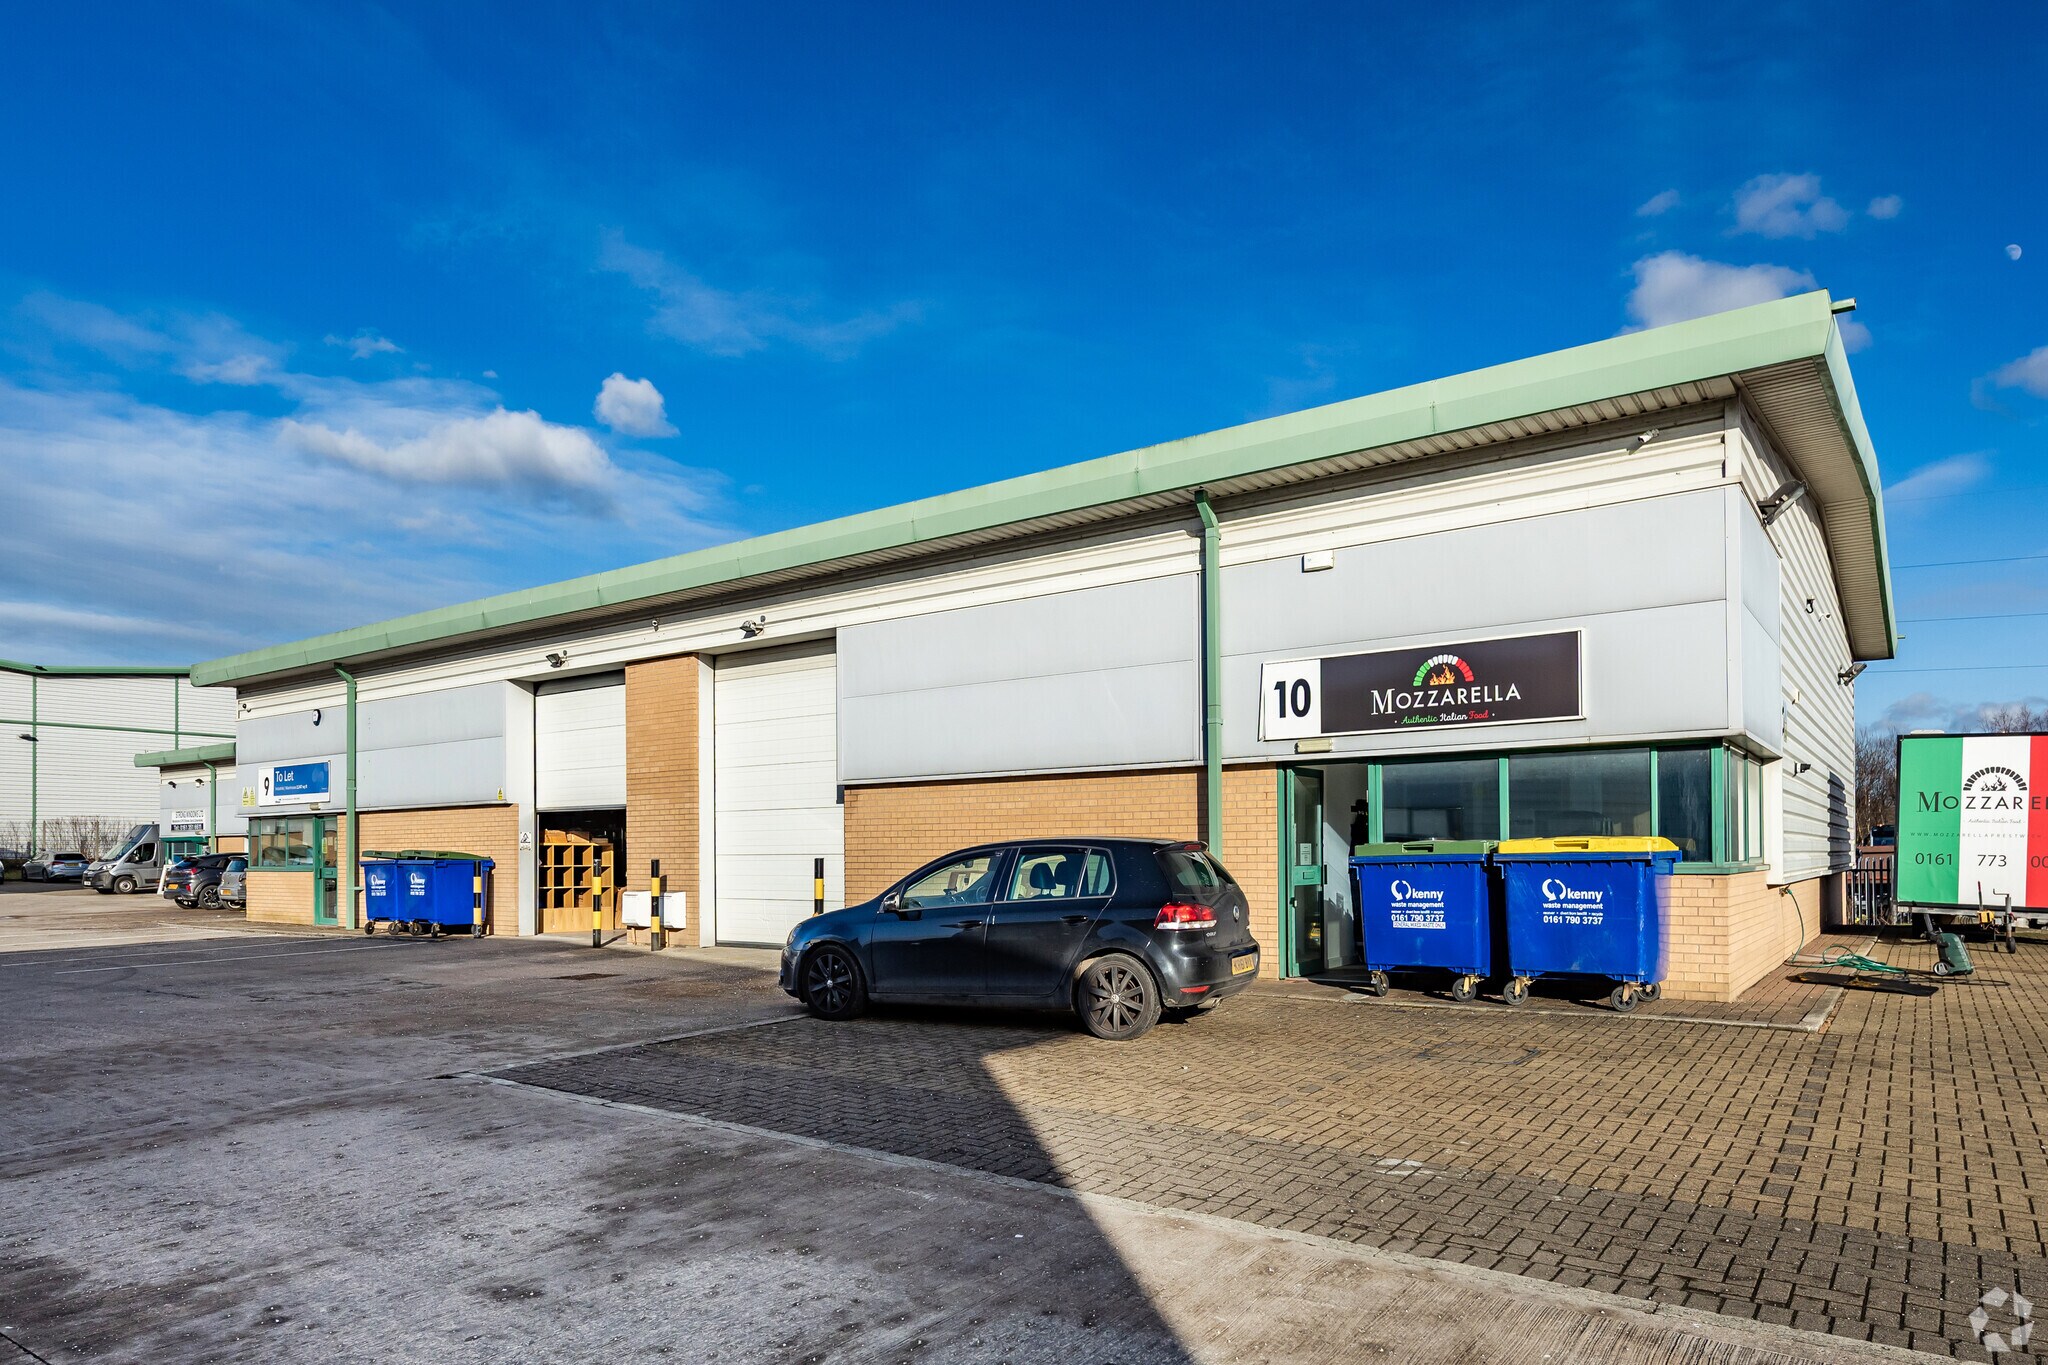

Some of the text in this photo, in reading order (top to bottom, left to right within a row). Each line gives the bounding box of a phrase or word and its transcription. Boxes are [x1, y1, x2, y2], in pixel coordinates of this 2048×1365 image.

[1273, 678, 1311, 718] 10
[1371, 683, 1522, 716] MOZZARELLA
[1401, 709, 1489, 725] Authentic Italian Food
[275, 770, 294, 782] To Let
[264, 776, 270, 796] 9
[1915, 852, 1952, 866] 0161
[1977, 854, 2007, 867] 773
[1412, 888, 1444, 902] kenny
[1567, 887, 1603, 903] kenny
[1408, 901, 1444, 909] management
[1562, 902, 1603, 911] management
[1391, 914, 1408, 922] 0161
[1543, 915, 1603, 925] 0161 790 3737
